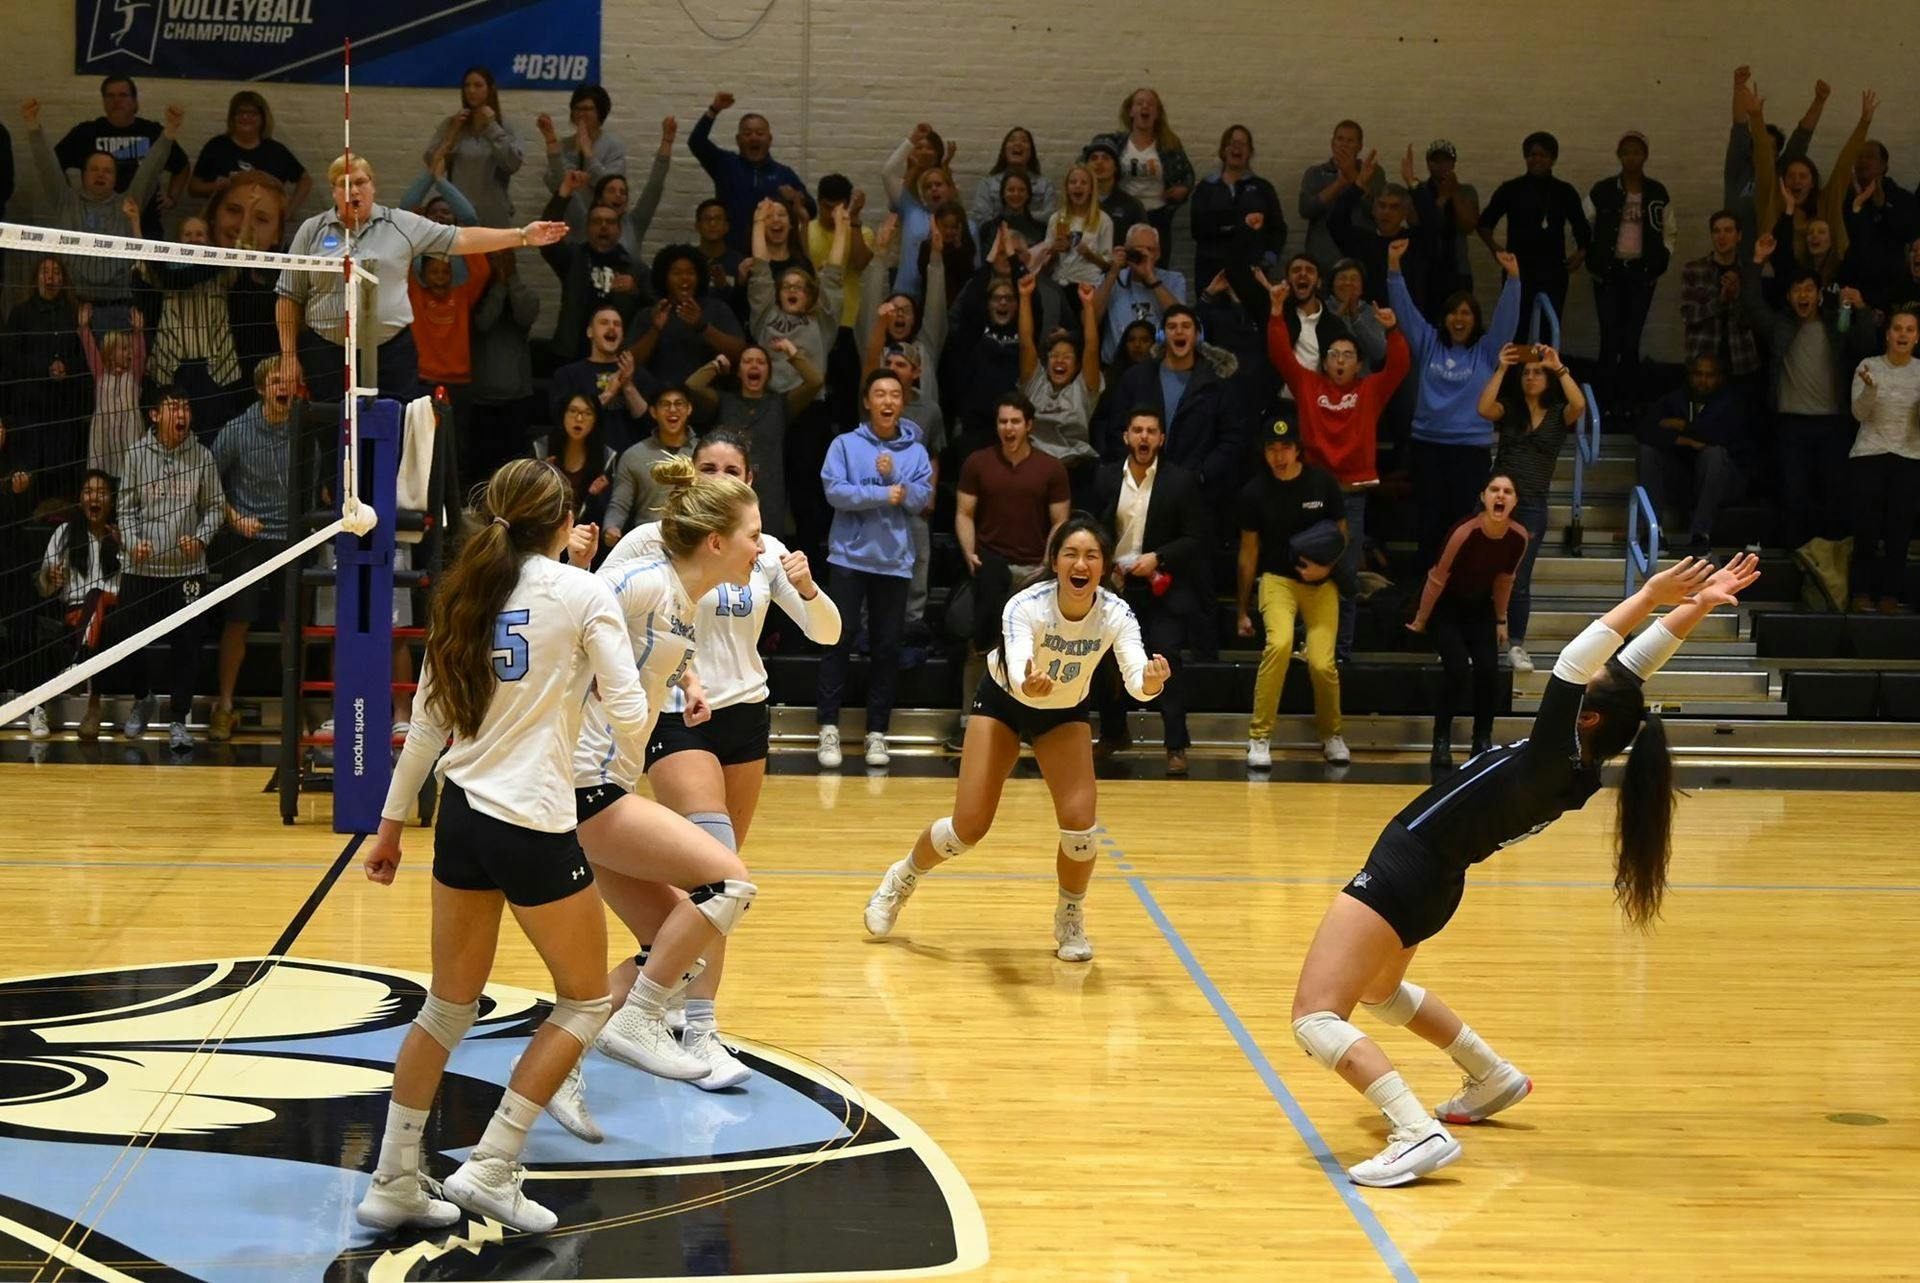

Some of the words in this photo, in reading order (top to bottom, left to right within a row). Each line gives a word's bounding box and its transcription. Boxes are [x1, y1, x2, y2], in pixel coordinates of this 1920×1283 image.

[168, 0, 314, 24] VOLLEYBALL
[163, 22, 295, 43] CHAMPIONSHIP
[512, 54, 589, 80] #D3VB
[715, 582, 753, 617] 13
[492, 609, 529, 682] 5
[1040, 633, 1102, 656] HOPKINS
[1046, 658, 1082, 683] 19
[353, 697, 365, 732] sports
[352, 733, 364, 776] imports
